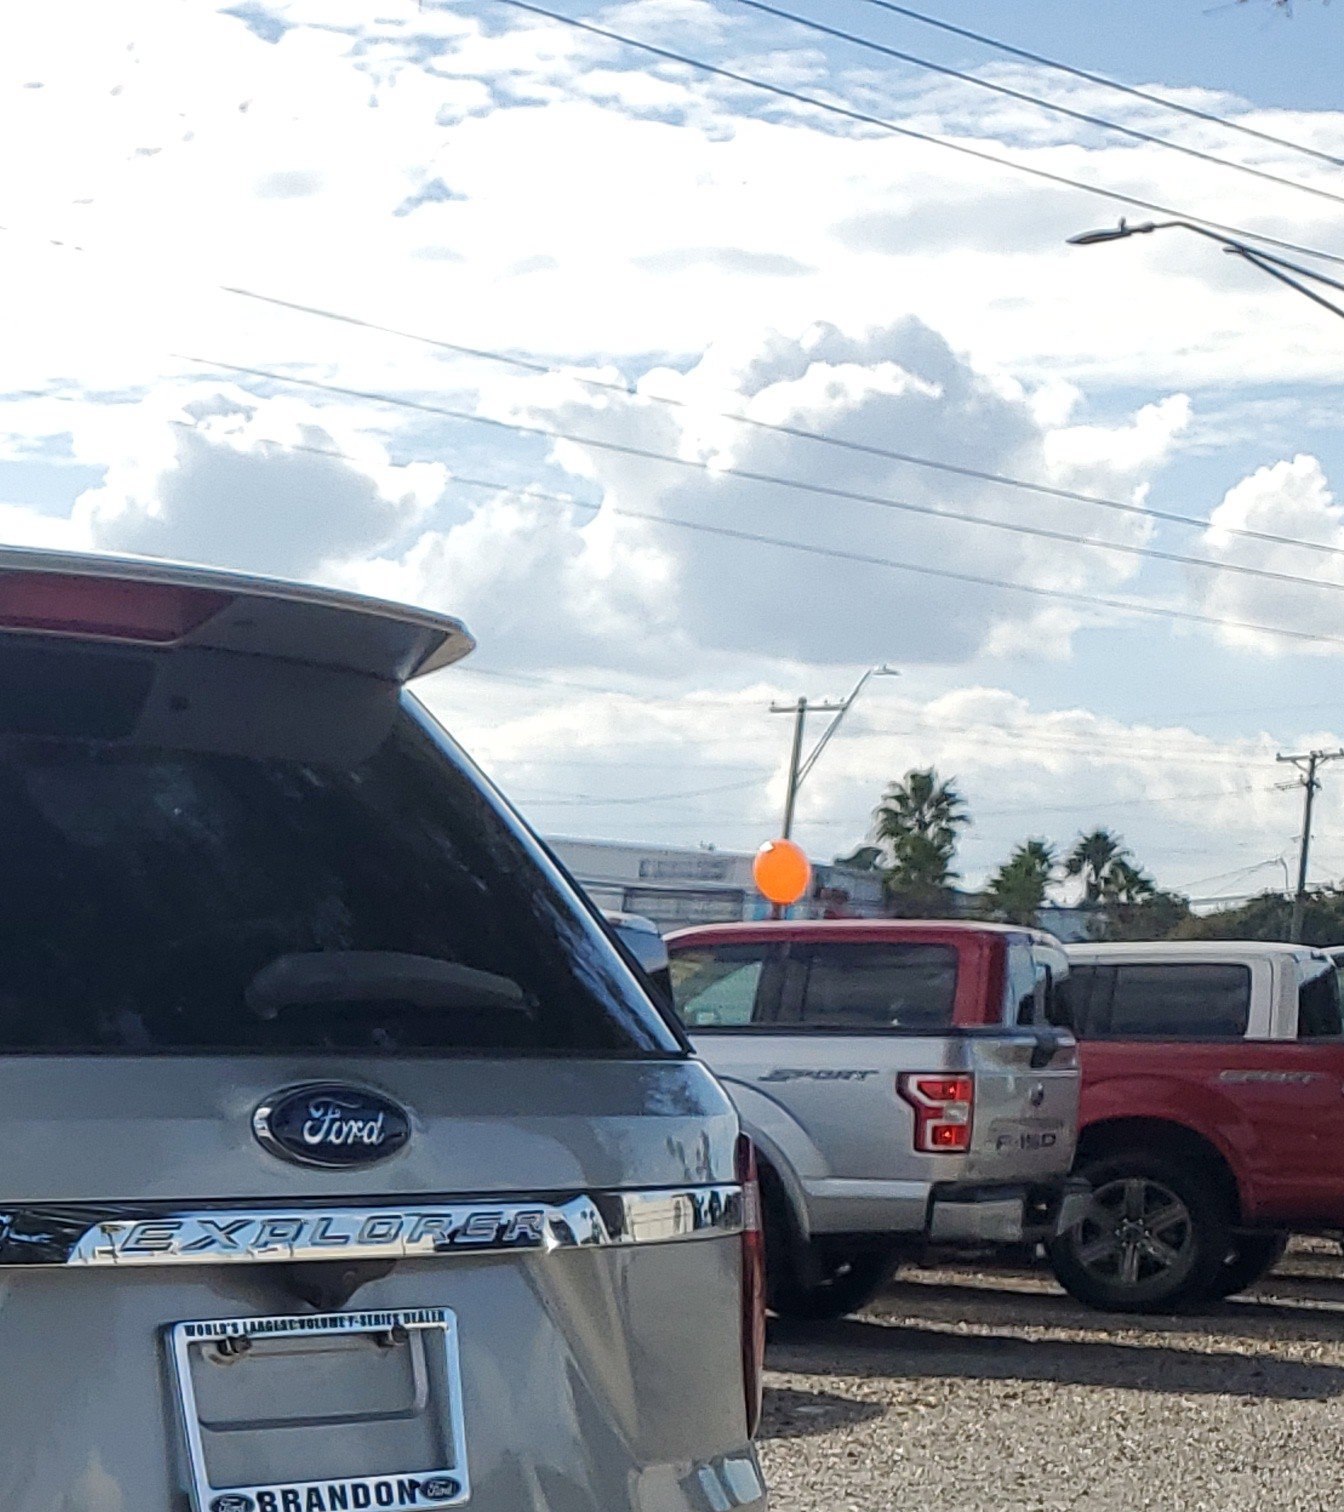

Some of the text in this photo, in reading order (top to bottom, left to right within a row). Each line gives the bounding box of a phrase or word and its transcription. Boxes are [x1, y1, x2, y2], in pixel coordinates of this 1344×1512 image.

[302, 1096, 386, 1146] Ford
[119, 1209, 547, 1252] EXPLORER
[184, 1321, 240, 1337] WORLD'S
